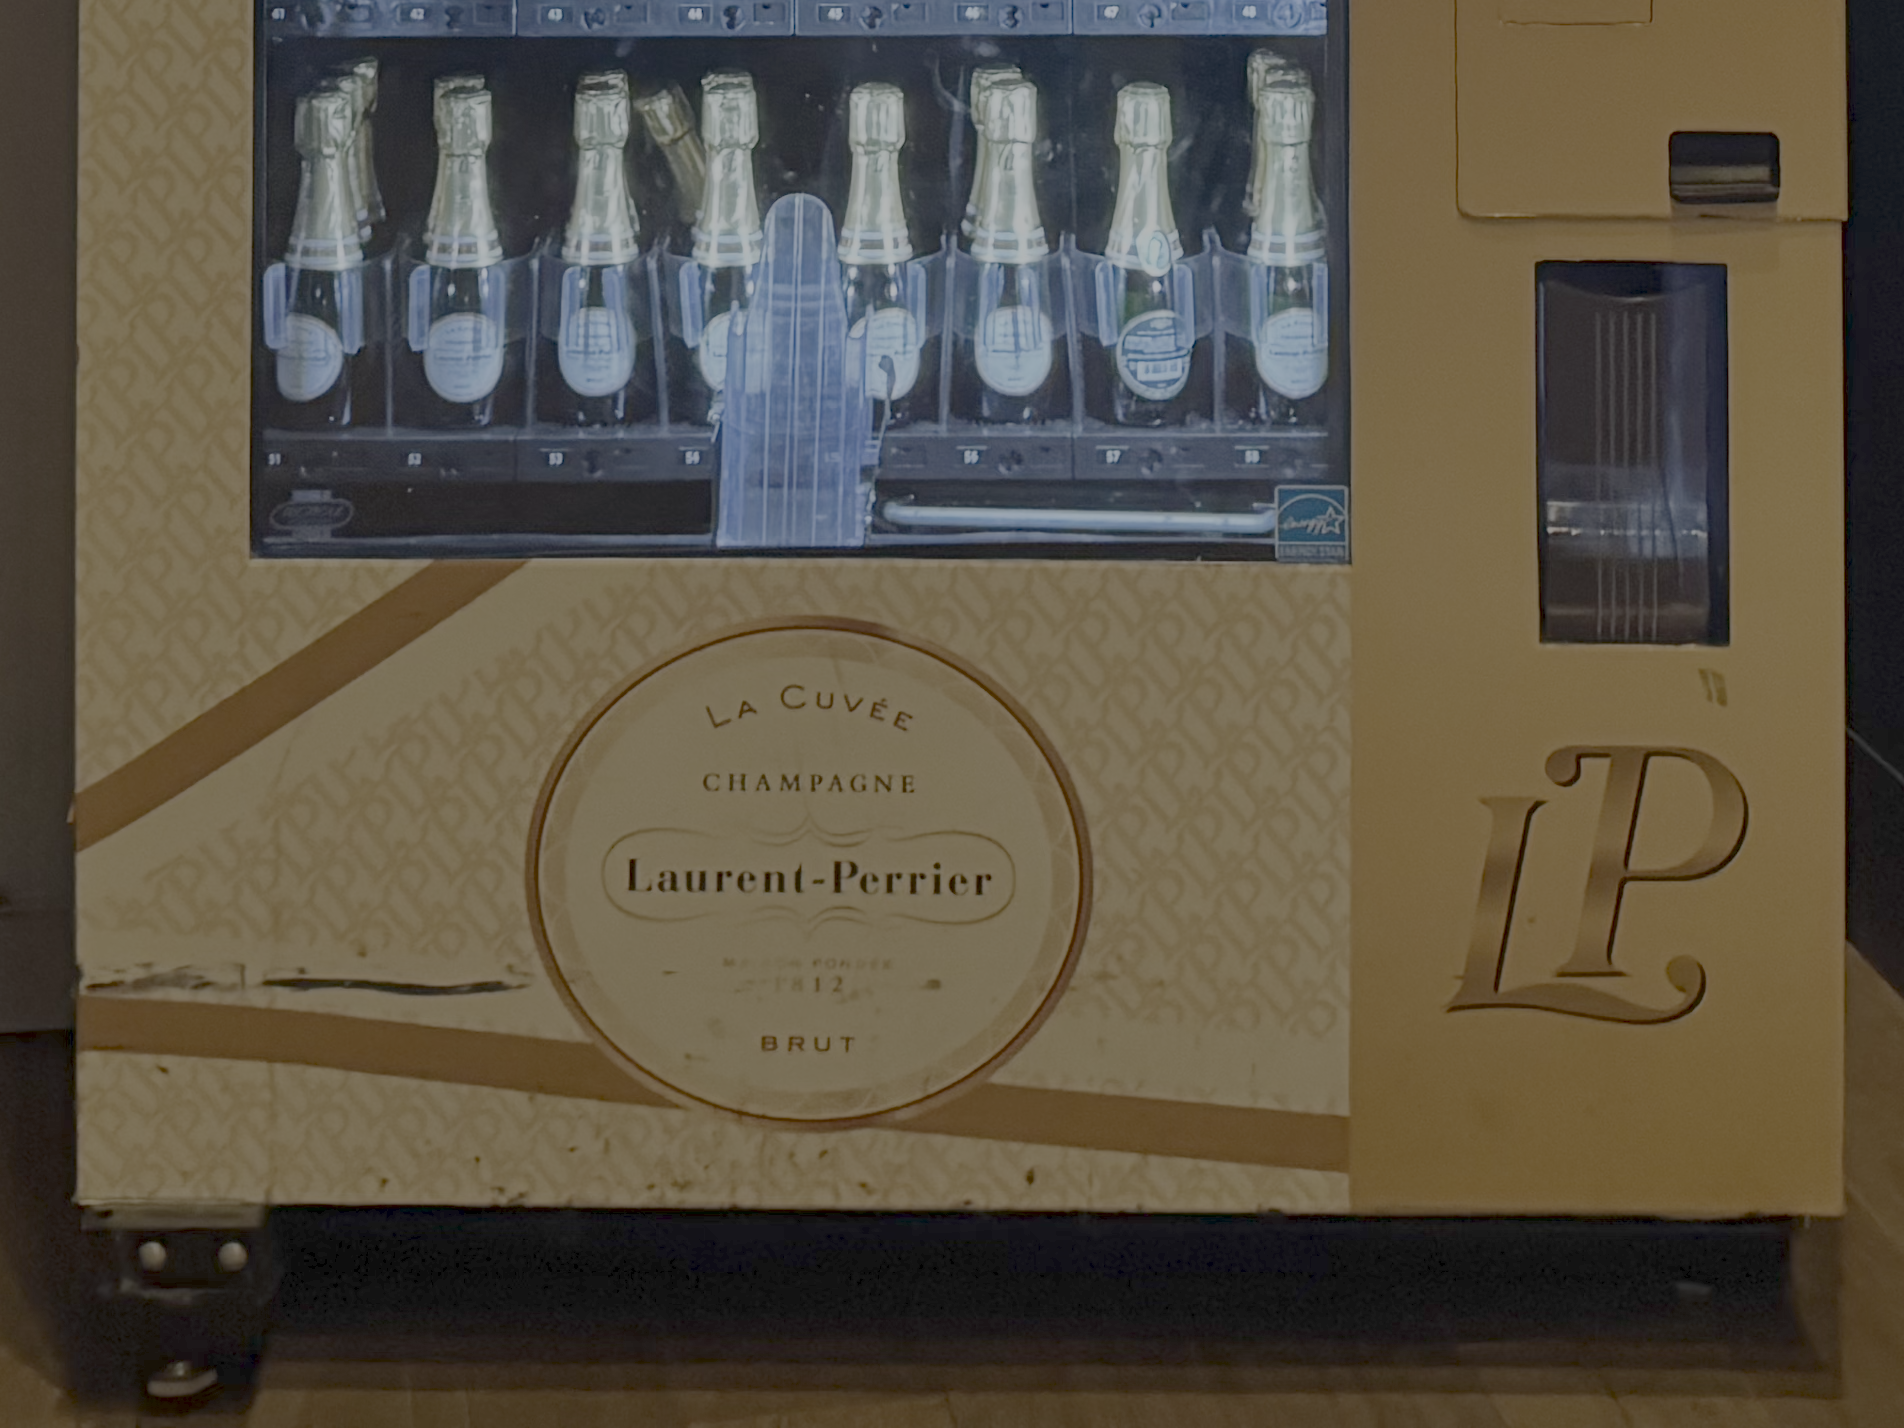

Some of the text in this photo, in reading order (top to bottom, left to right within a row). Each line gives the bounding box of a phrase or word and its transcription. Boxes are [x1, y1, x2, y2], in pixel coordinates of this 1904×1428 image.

[705, 683, 914, 733] LA CUVÉE
[702, 773, 915, 794] CHAMPAGNE
[628, 858, 992, 896] Laurent-Perrier
[1446, 744, 1749, 1025] LP
[760, 1035, 855, 1053] BRUT
